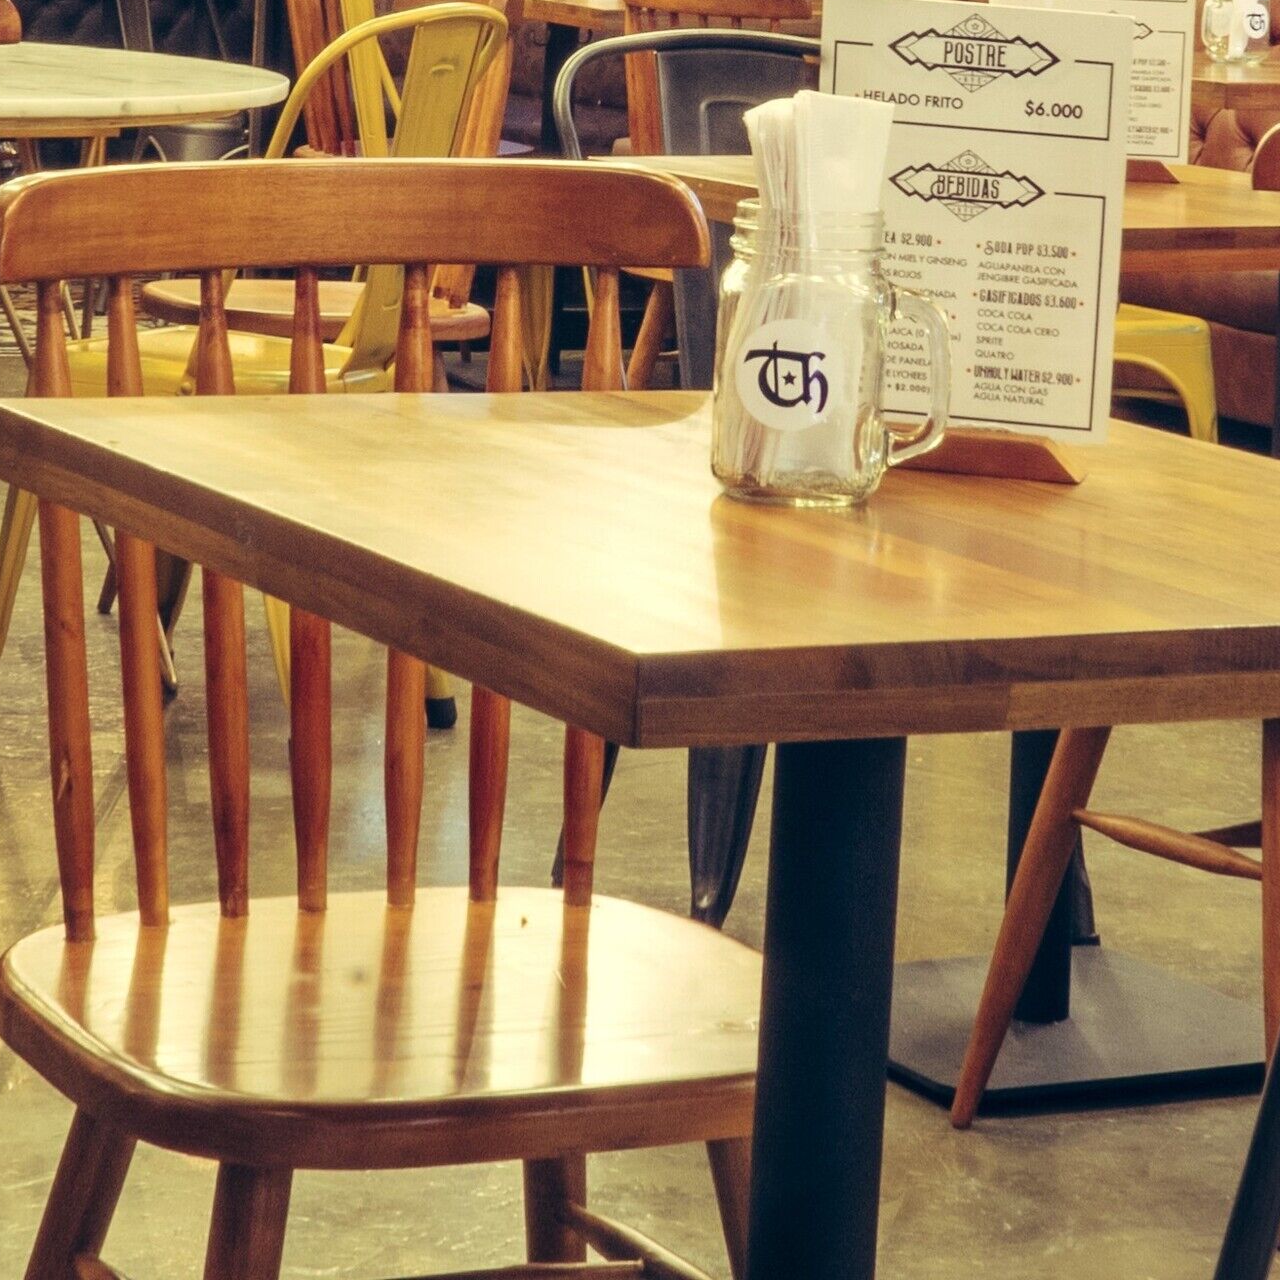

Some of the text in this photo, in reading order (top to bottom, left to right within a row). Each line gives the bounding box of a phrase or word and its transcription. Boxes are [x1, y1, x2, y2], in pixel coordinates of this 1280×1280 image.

[943, 41, 1006, 67] POSTRE
[862, 90, 1084, 120] HELADO FRITO $6.000
[931, 173, 1000, 201] BEBIDAS
[884, 231, 933, 247] EA $2.900
[1015, 242, 1034, 256] POP
[1037, 244, 1069, 259] $3.500
[898, 253, 917, 263] MIEL
[919, 255, 926, 263] Y
[926, 256, 968, 268] GINSENG
[977, 261, 1066, 276] AGUAPANELA CON
[892, 269, 922, 280] ROJOS
[976, 272, 1079, 289] JENGIBRE GASIFICADA
[979, 289, 1077, 310] GASIFICADOS $3.600
[977, 308, 1033, 322] COCA COLA
[976, 321, 1060, 338] COCA COLA CERO
[976, 335, 1004, 346] SPRITE
[974, 348, 1015, 361] QUATRO
[1010, 367, 1040, 383] WATER
[1041, 371, 1074, 386] $2.900
[973, 382, 1049, 397] AGUA CON GAS
[973, 392, 1045, 407] AGUA NATURAL
